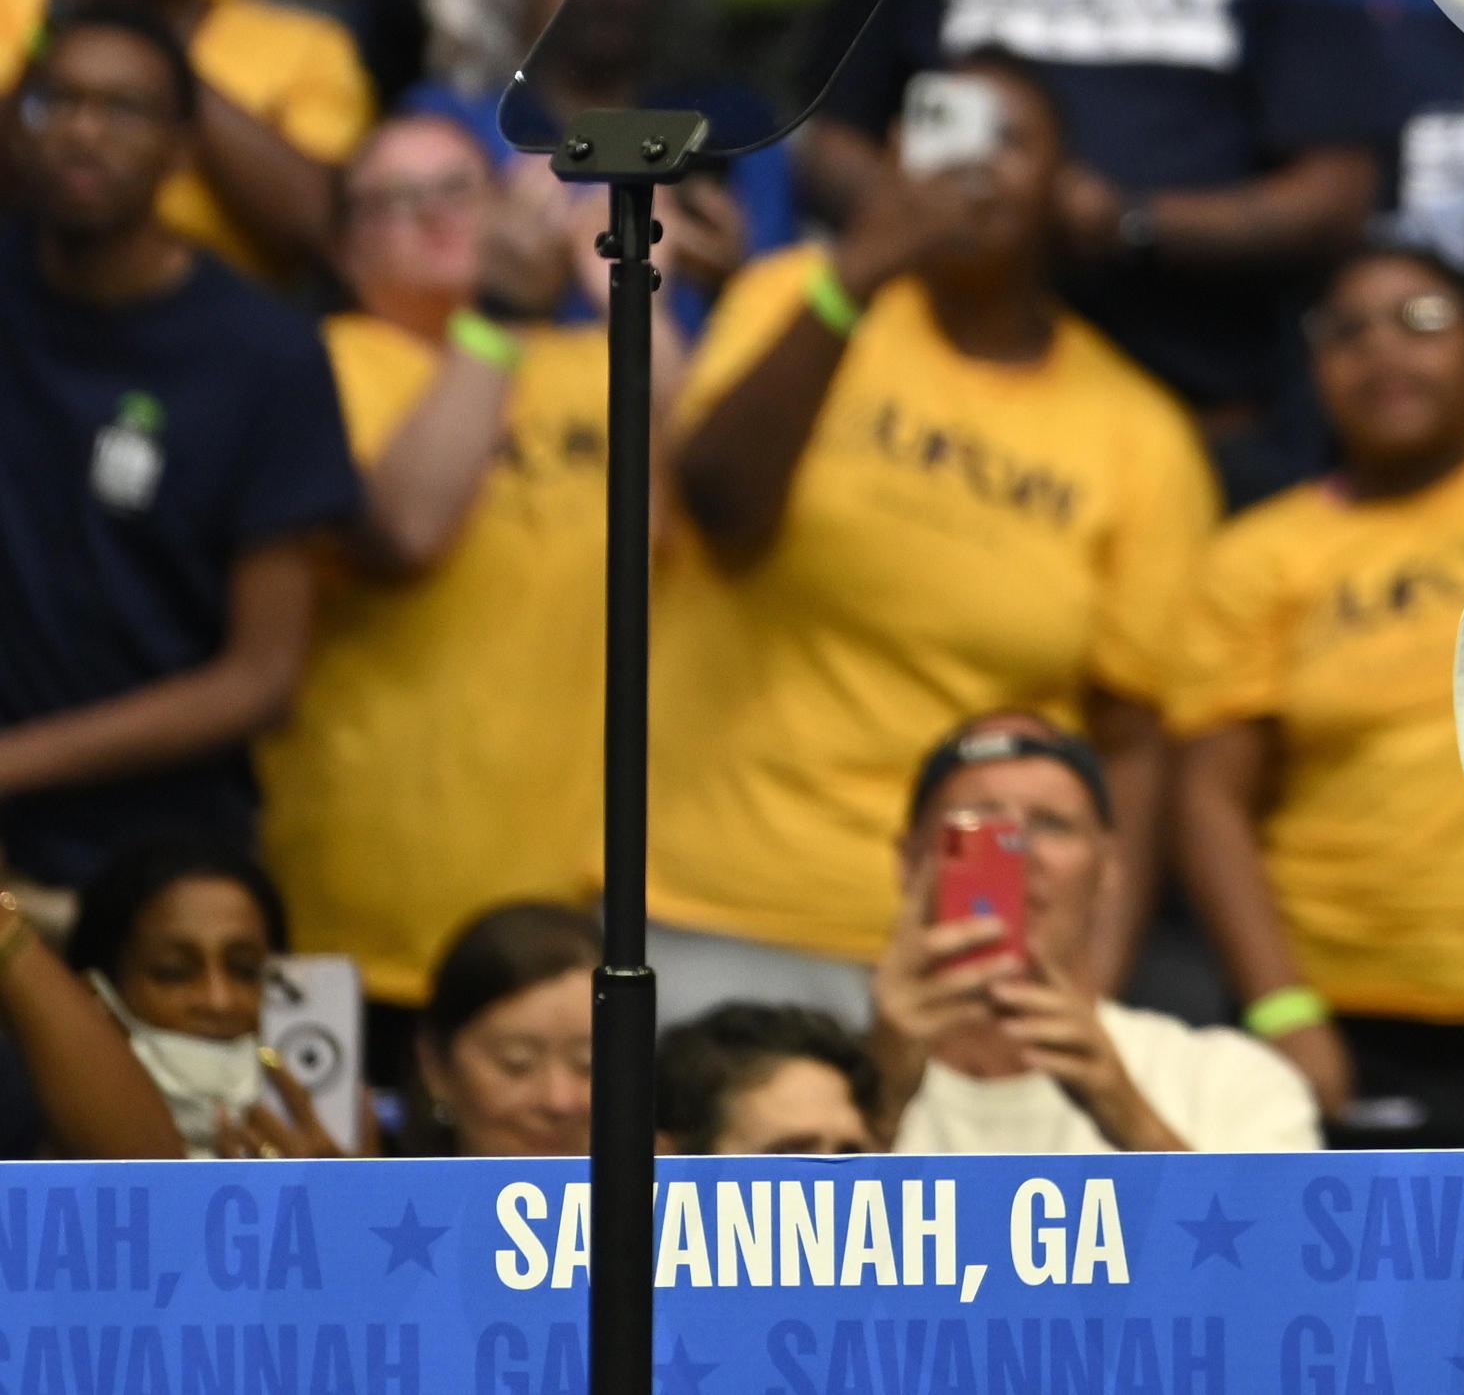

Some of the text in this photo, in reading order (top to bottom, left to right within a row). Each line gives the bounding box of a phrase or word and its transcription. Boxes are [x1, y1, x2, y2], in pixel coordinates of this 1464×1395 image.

[204, 1184, 324, 1293] GA
[495, 1177, 1130, 1304] SAANNAH, GA
[474, 1320, 591, 1395] GA
[1280, 1314, 1397, 1395] GA
